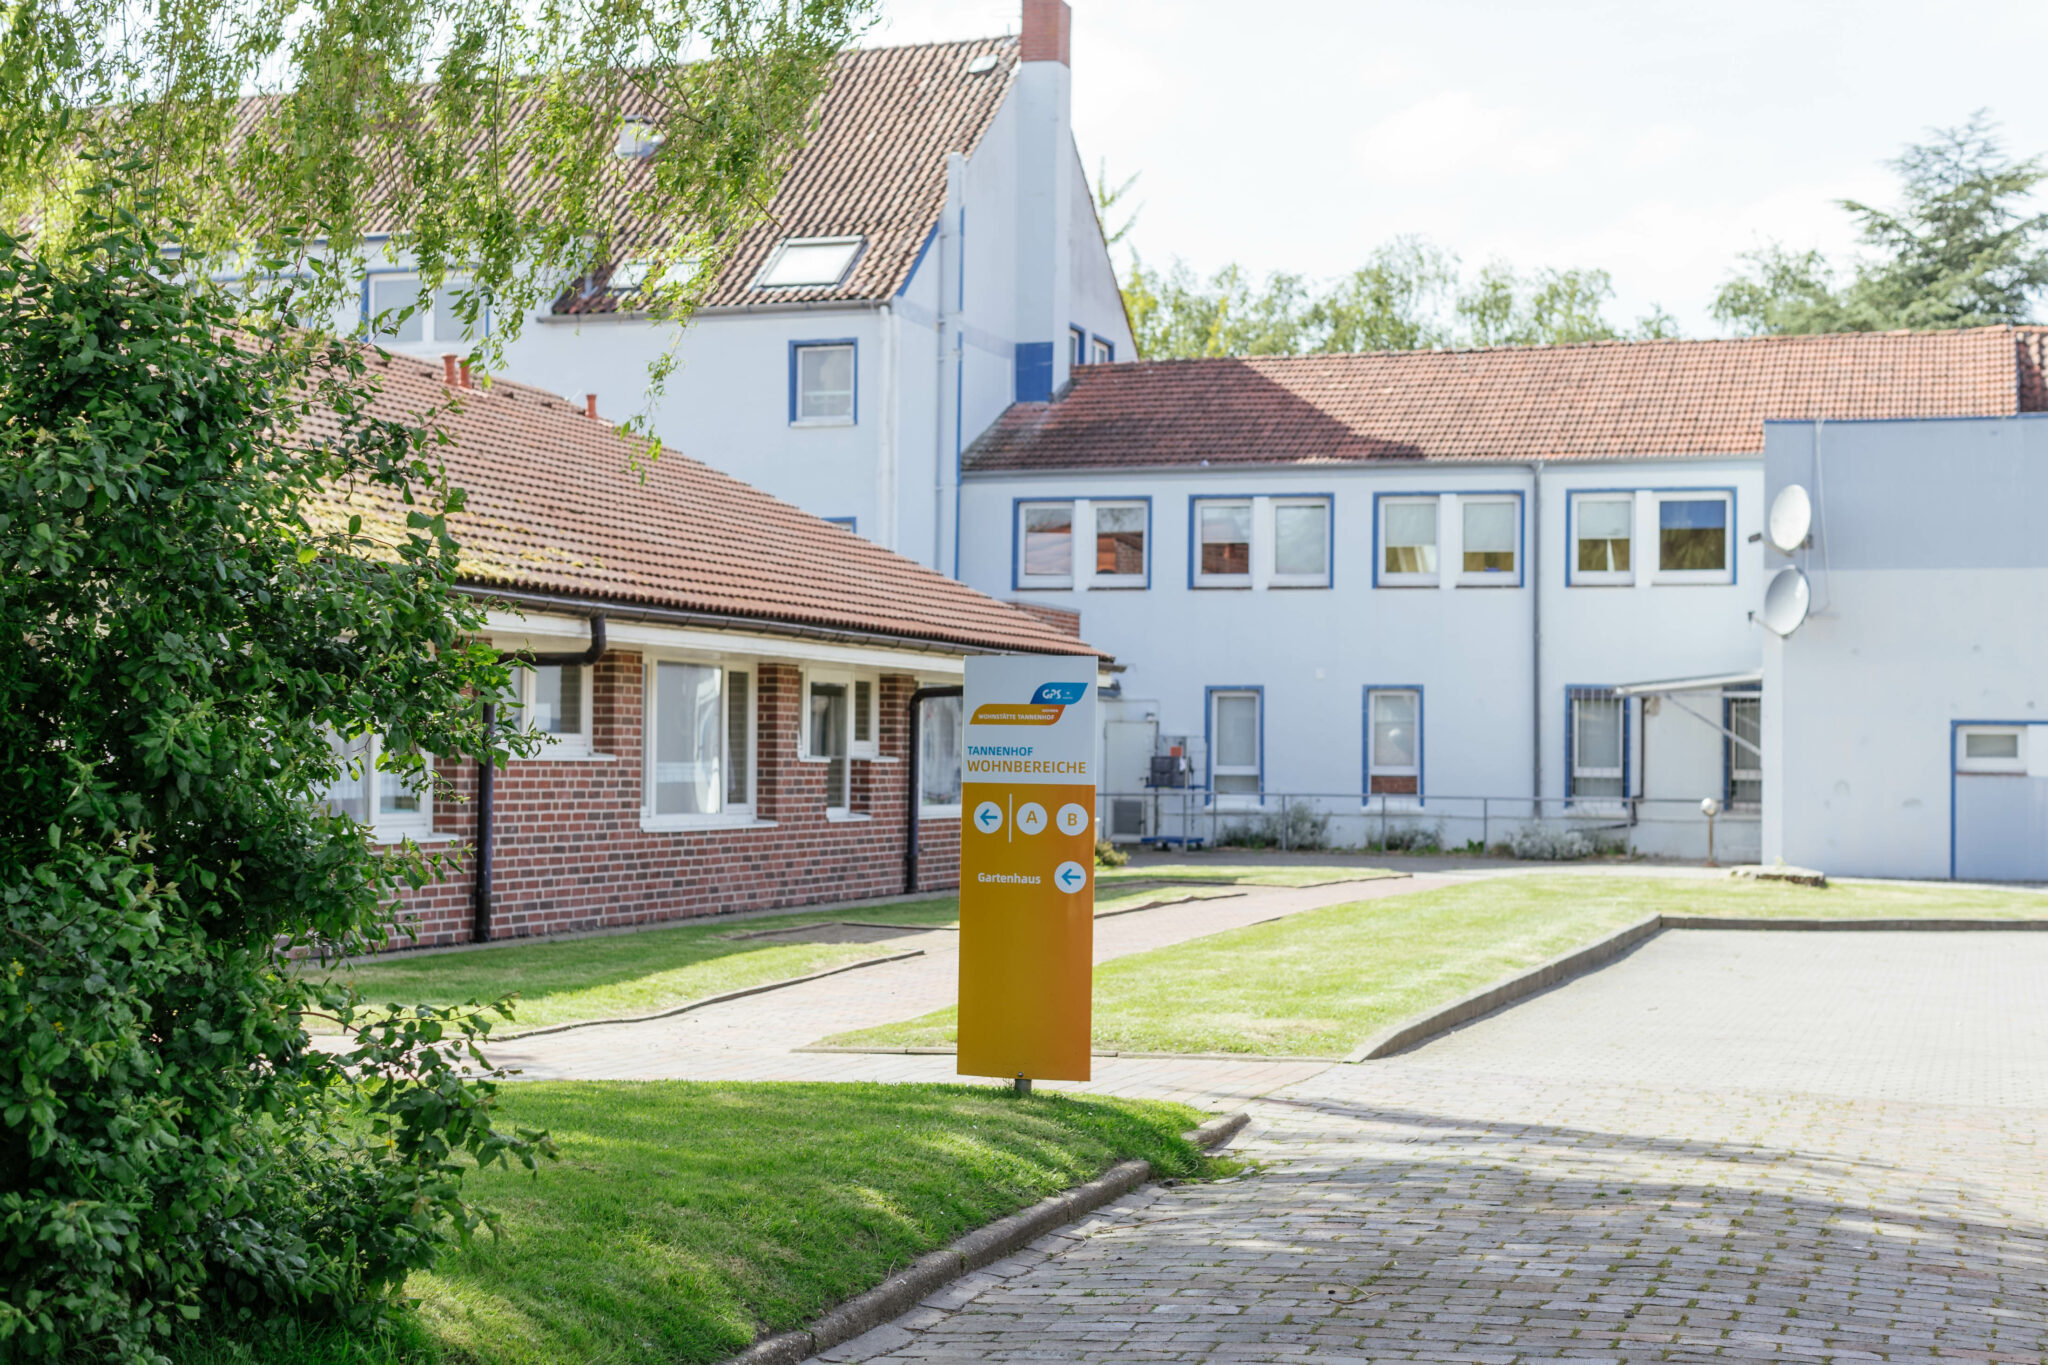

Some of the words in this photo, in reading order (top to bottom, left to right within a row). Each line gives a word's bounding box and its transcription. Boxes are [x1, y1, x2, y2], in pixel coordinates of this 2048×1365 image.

[1042, 689, 1062, 699] GPS
[967, 746, 1033, 756] TANNENHOF
[967, 759, 1086, 774] WOHNBEREICHE
[1025, 810, 1038, 824] A
[1067, 813, 1078, 826] B
[977, 872, 1041, 884] Gartenhaus
